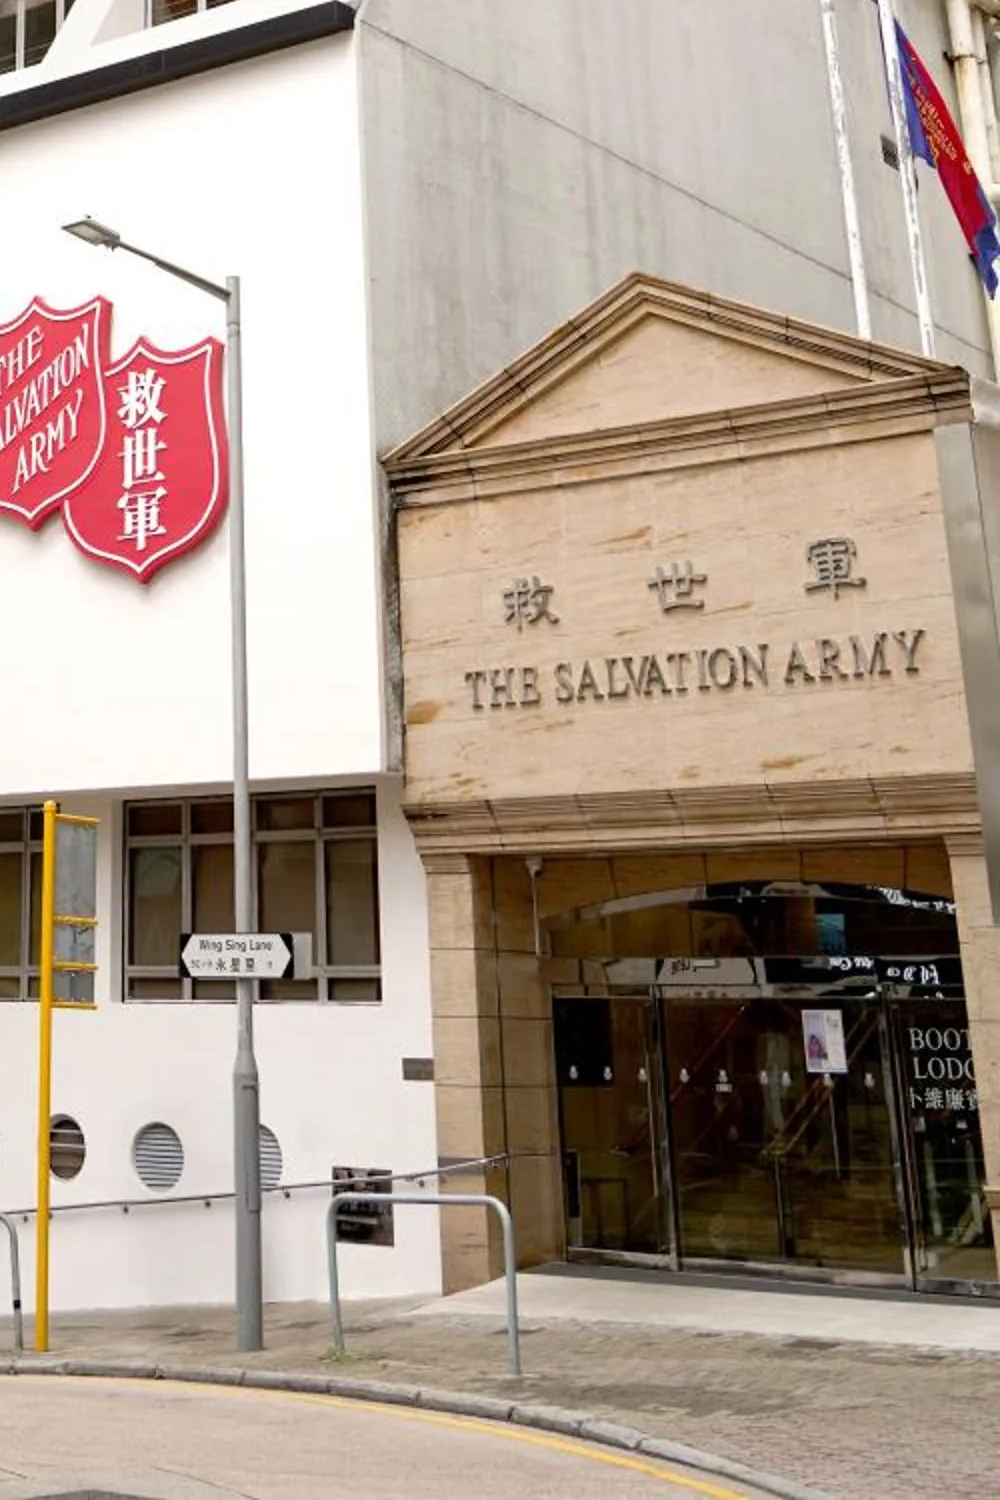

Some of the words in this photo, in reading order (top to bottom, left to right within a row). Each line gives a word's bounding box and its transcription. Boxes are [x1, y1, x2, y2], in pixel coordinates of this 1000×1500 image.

[11, 388, 83, 495] ARMY
[116, 367, 169, 551] 救世軍
[502, 536, 867, 633] 救世軍
[465, 666, 542, 709] THE
[554, 643, 770, 702] SALVATION
[784, 628, 926, 684] ARMY
[199, 939, 223, 952] Wing
[225, 939, 247, 952] Sing
[249, 939, 273, 951] Lane
